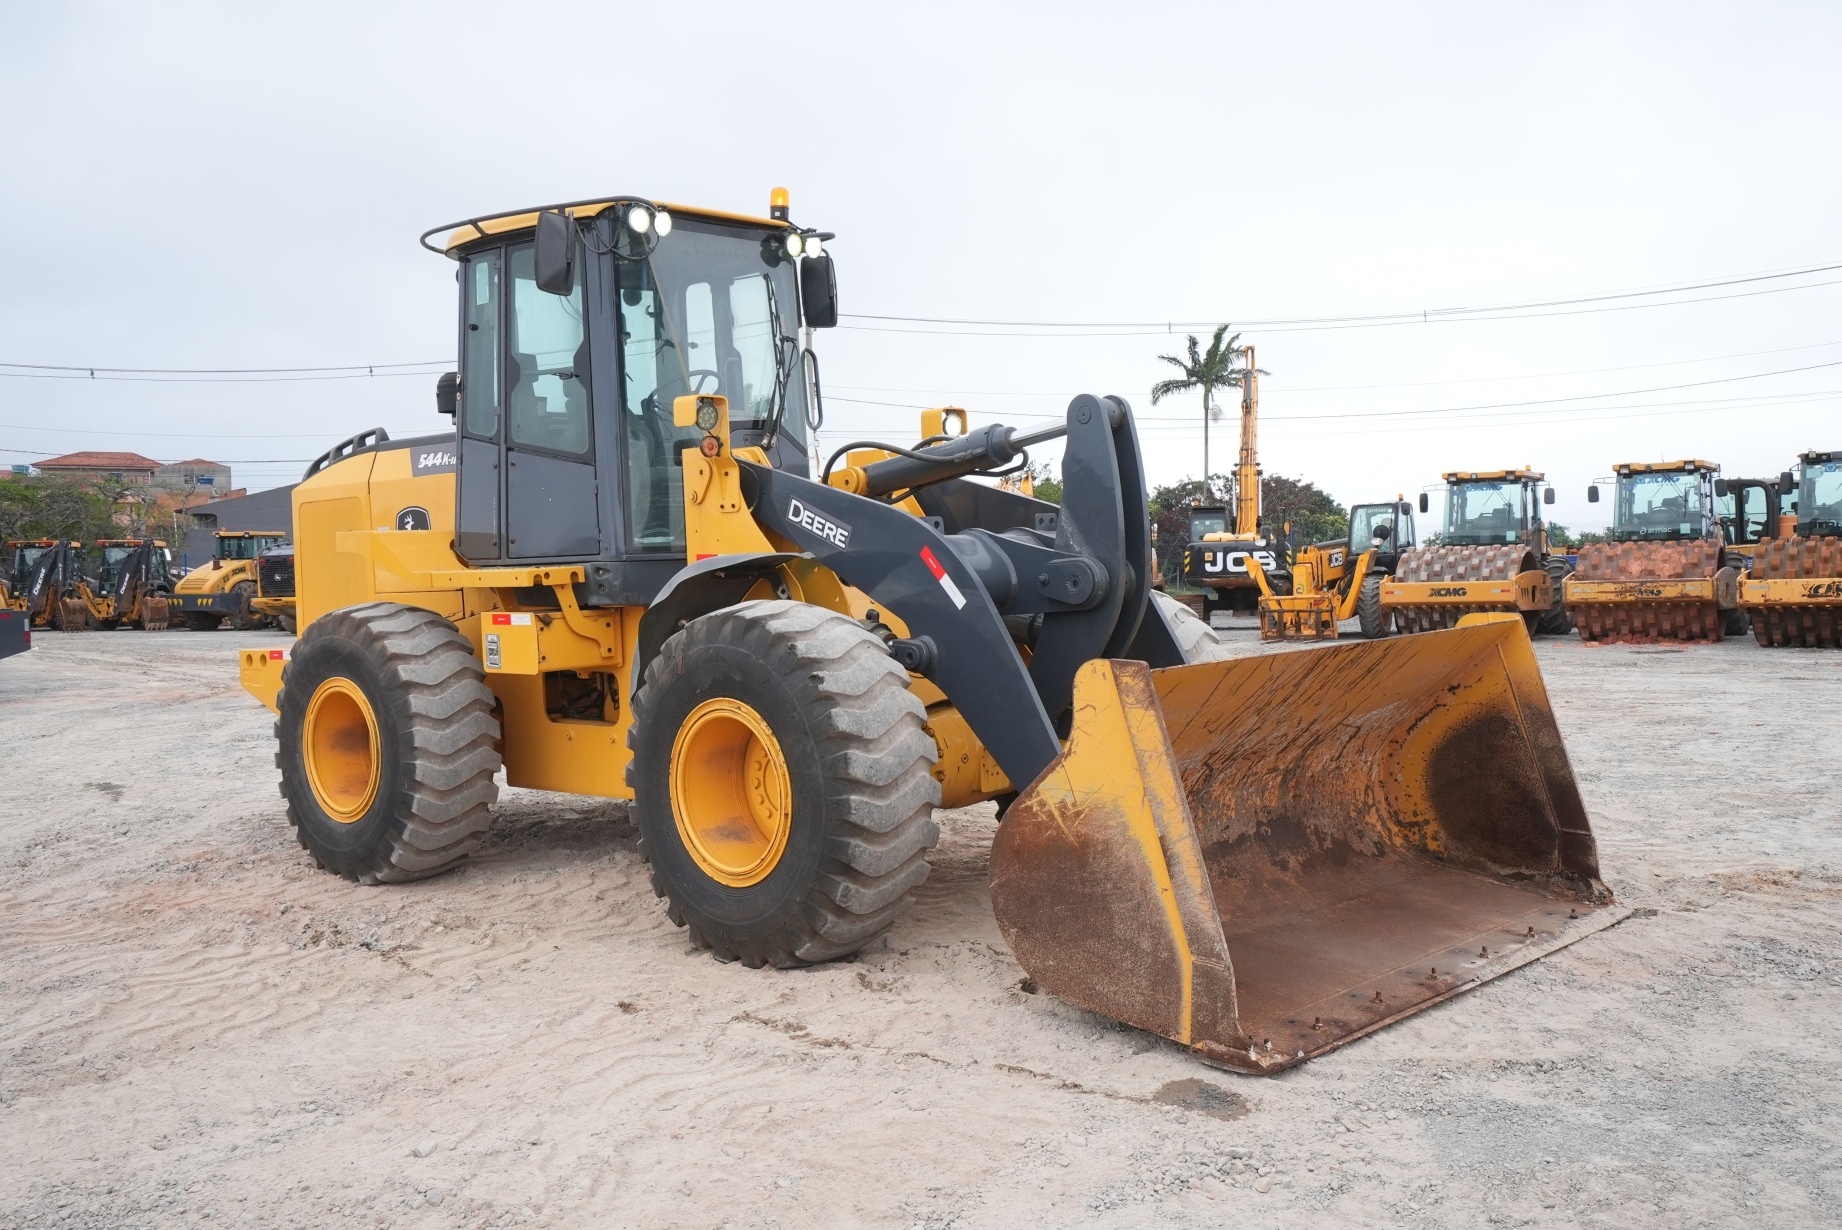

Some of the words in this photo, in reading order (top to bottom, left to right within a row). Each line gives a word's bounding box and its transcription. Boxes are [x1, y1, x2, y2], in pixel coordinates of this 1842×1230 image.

[788, 499, 848, 548] DEERE
[1205, 551, 1276, 572] JCB
[1330, 553, 1343, 567] JCB
[33, 567, 46, 595] DEERE
[1428, 588, 1467, 597] XCMG
